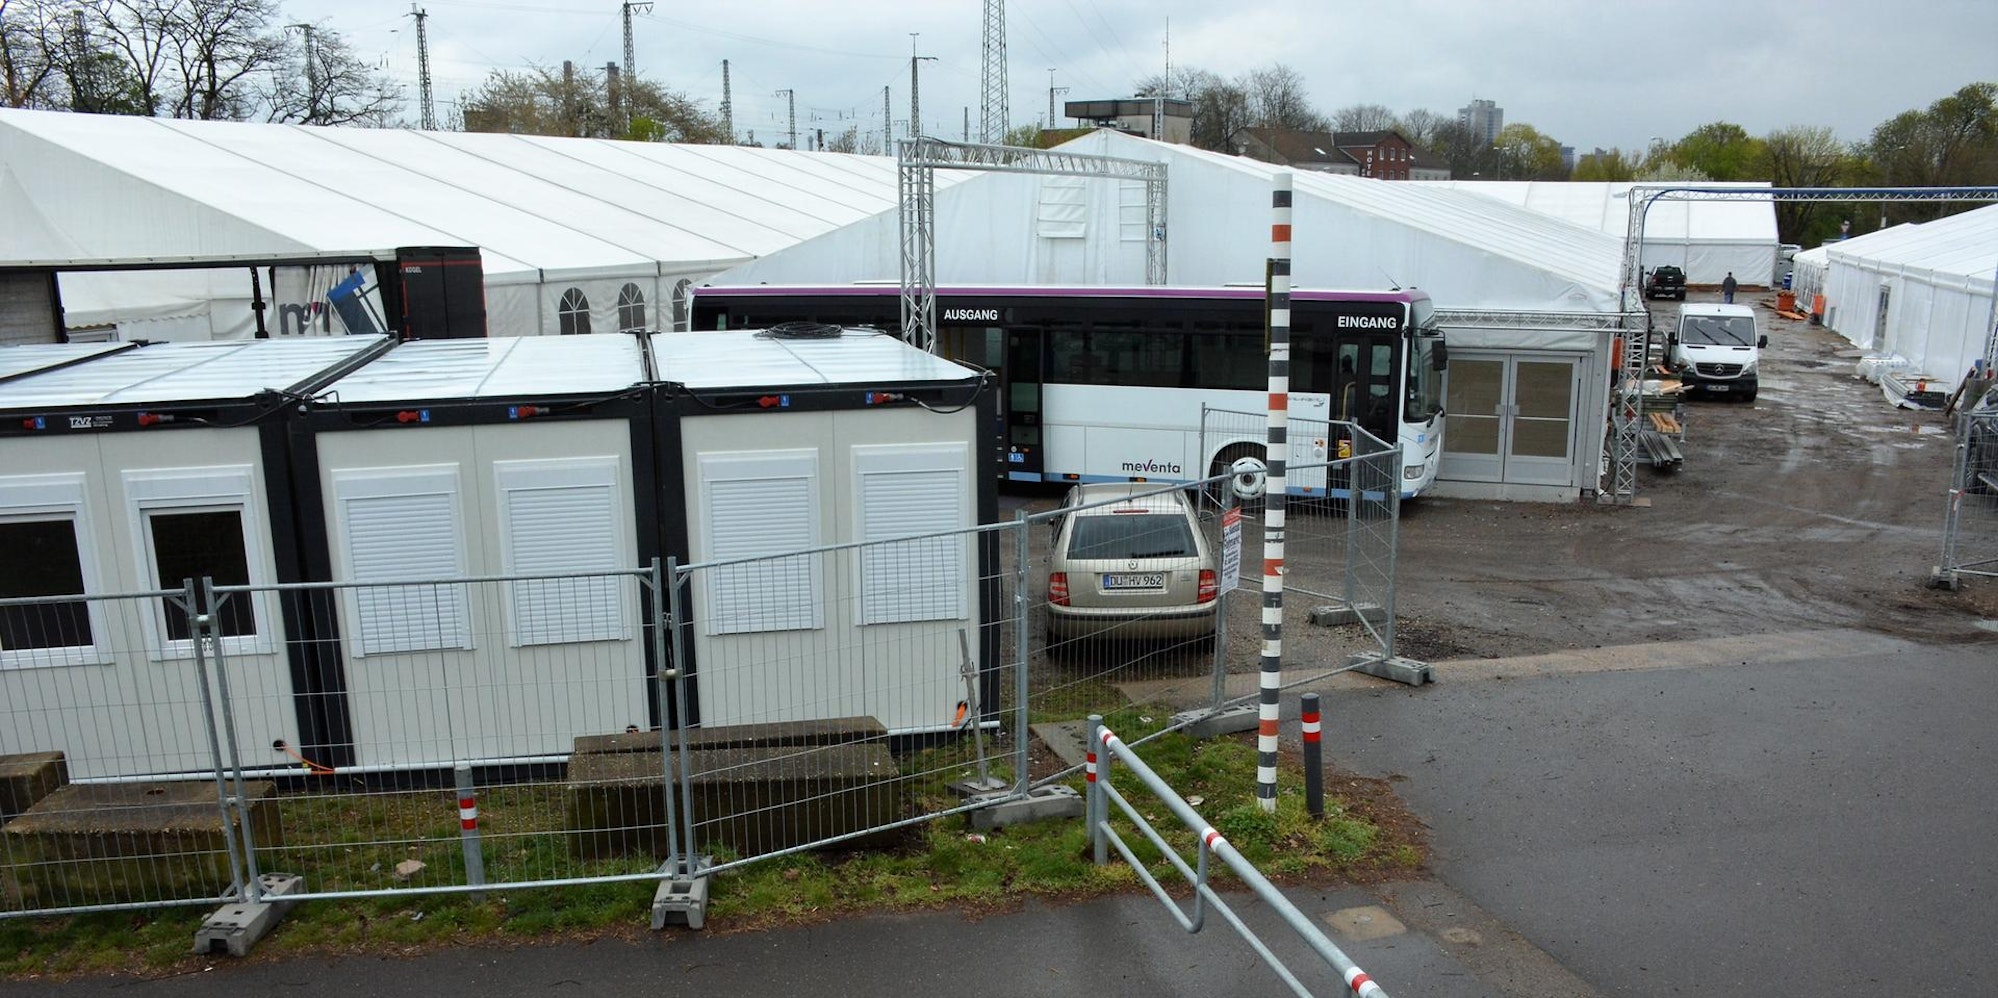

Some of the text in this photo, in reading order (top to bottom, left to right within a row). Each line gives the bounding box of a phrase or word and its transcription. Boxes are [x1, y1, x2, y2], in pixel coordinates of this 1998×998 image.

[944, 309, 998, 320] AUSGANG
[1337, 316, 1397, 329] EINGANG
[1122, 459, 1181, 474] meventa
[1110, 574, 1162, 588] DU HV 962
